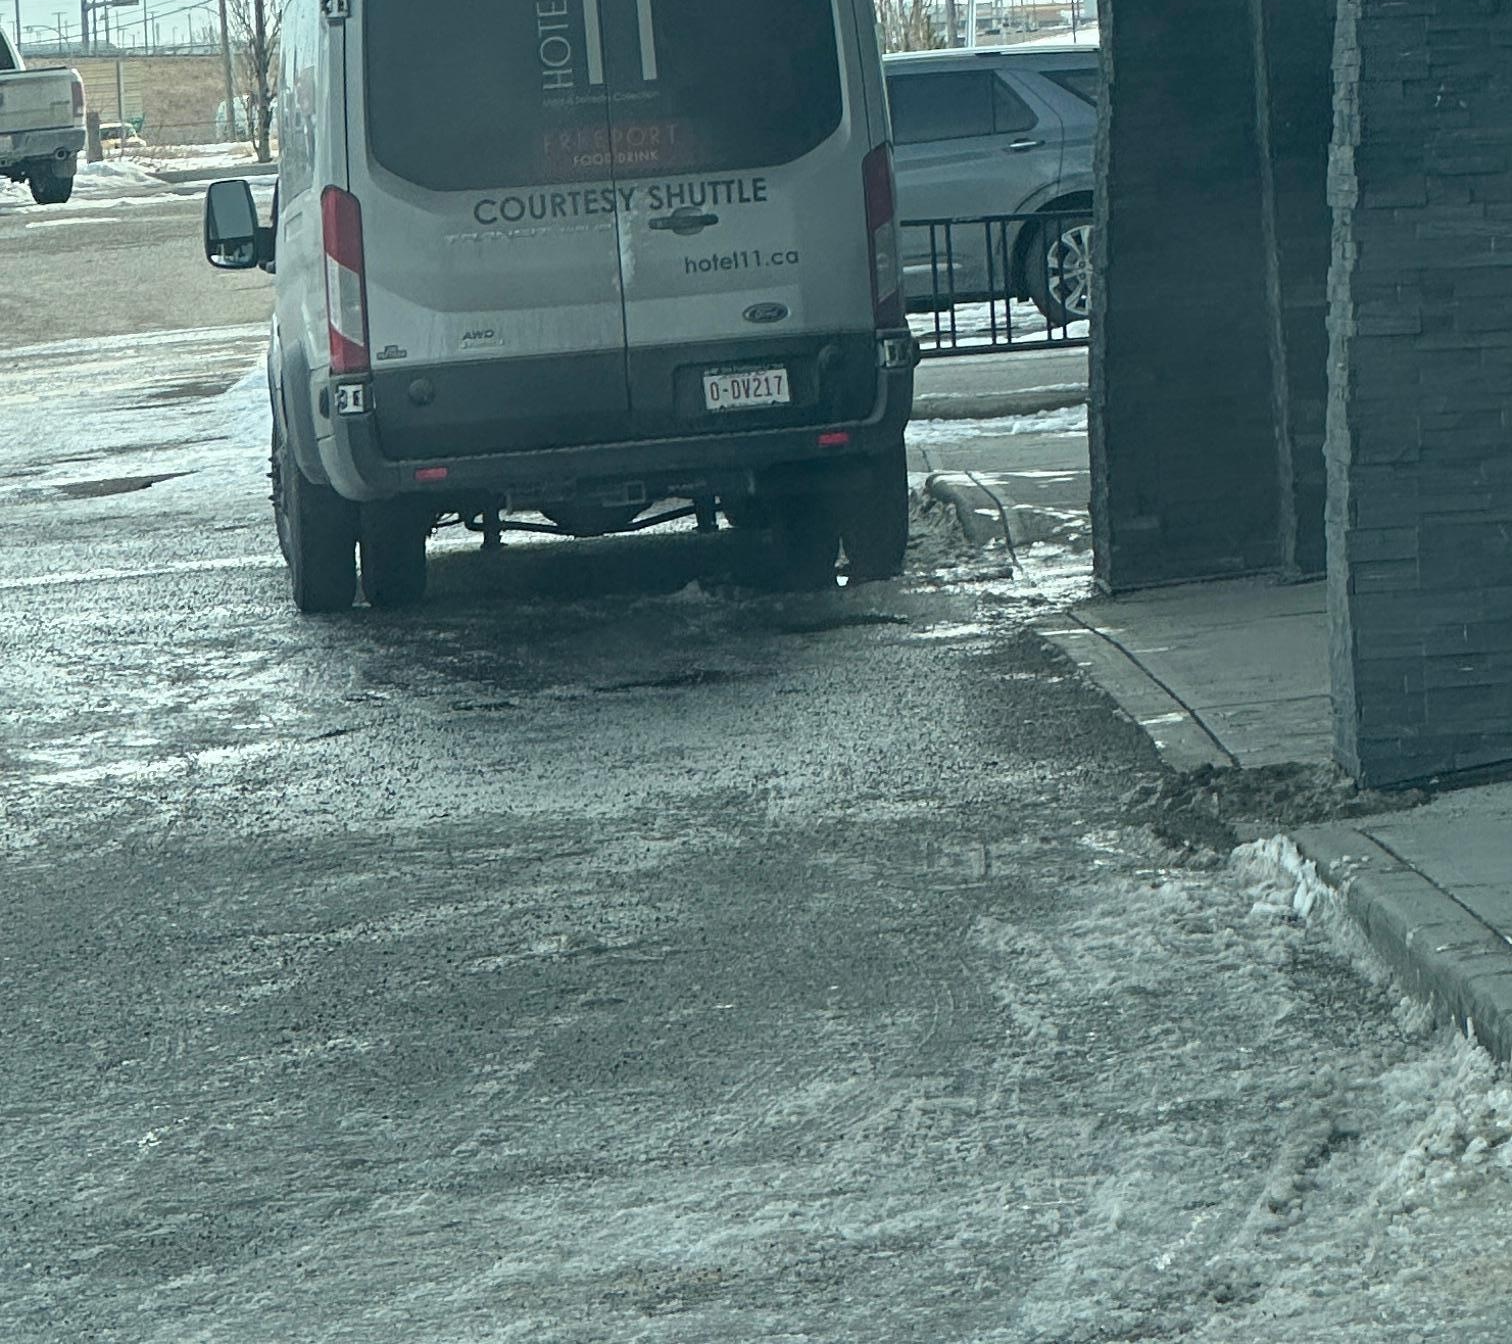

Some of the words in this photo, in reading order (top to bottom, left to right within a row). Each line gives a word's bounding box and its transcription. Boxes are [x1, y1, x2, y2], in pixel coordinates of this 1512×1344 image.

[618, 150, 659, 163] DRINK
[473, 186, 636, 225] COURTESY
[648, 177, 767, 211] SHUTTLE
[685, 249, 799, 274] hotel11.ca
[462, 329, 495, 341] AWD
